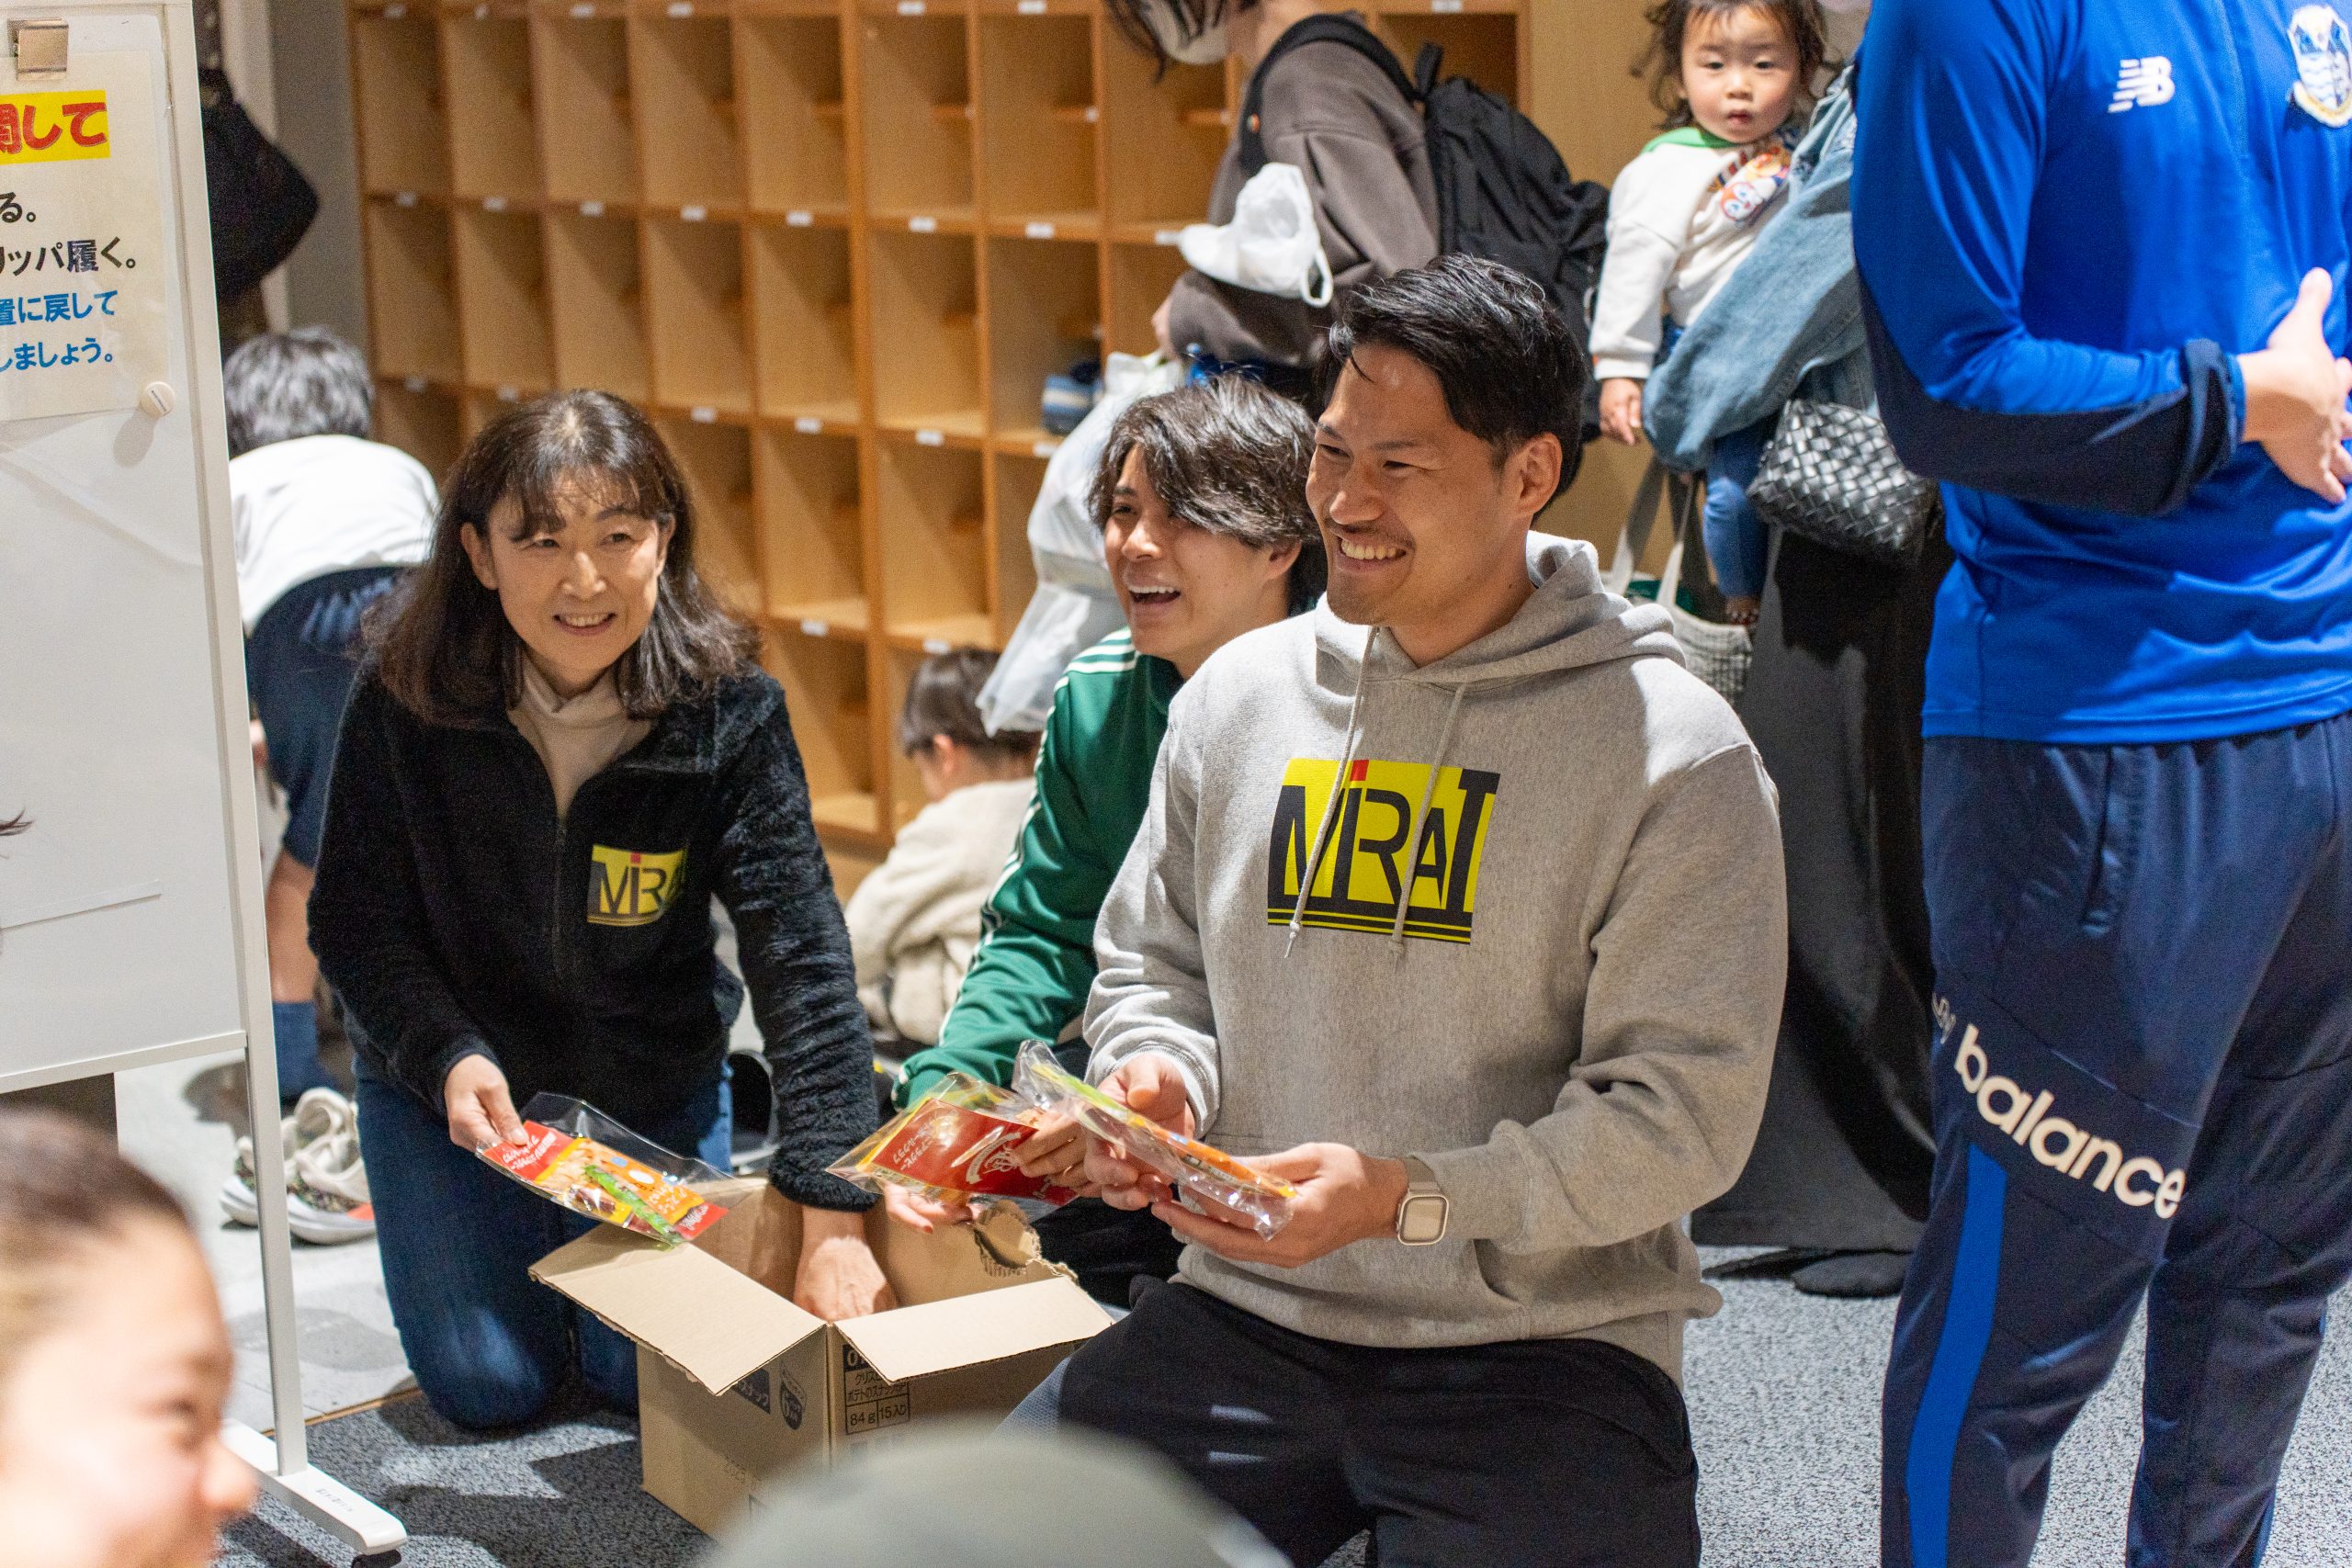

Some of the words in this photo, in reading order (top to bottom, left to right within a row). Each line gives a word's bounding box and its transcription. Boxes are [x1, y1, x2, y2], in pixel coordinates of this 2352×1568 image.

[0, 236, 136, 276] ッパ履く。
[1954, 1022, 2187, 1220] balance
